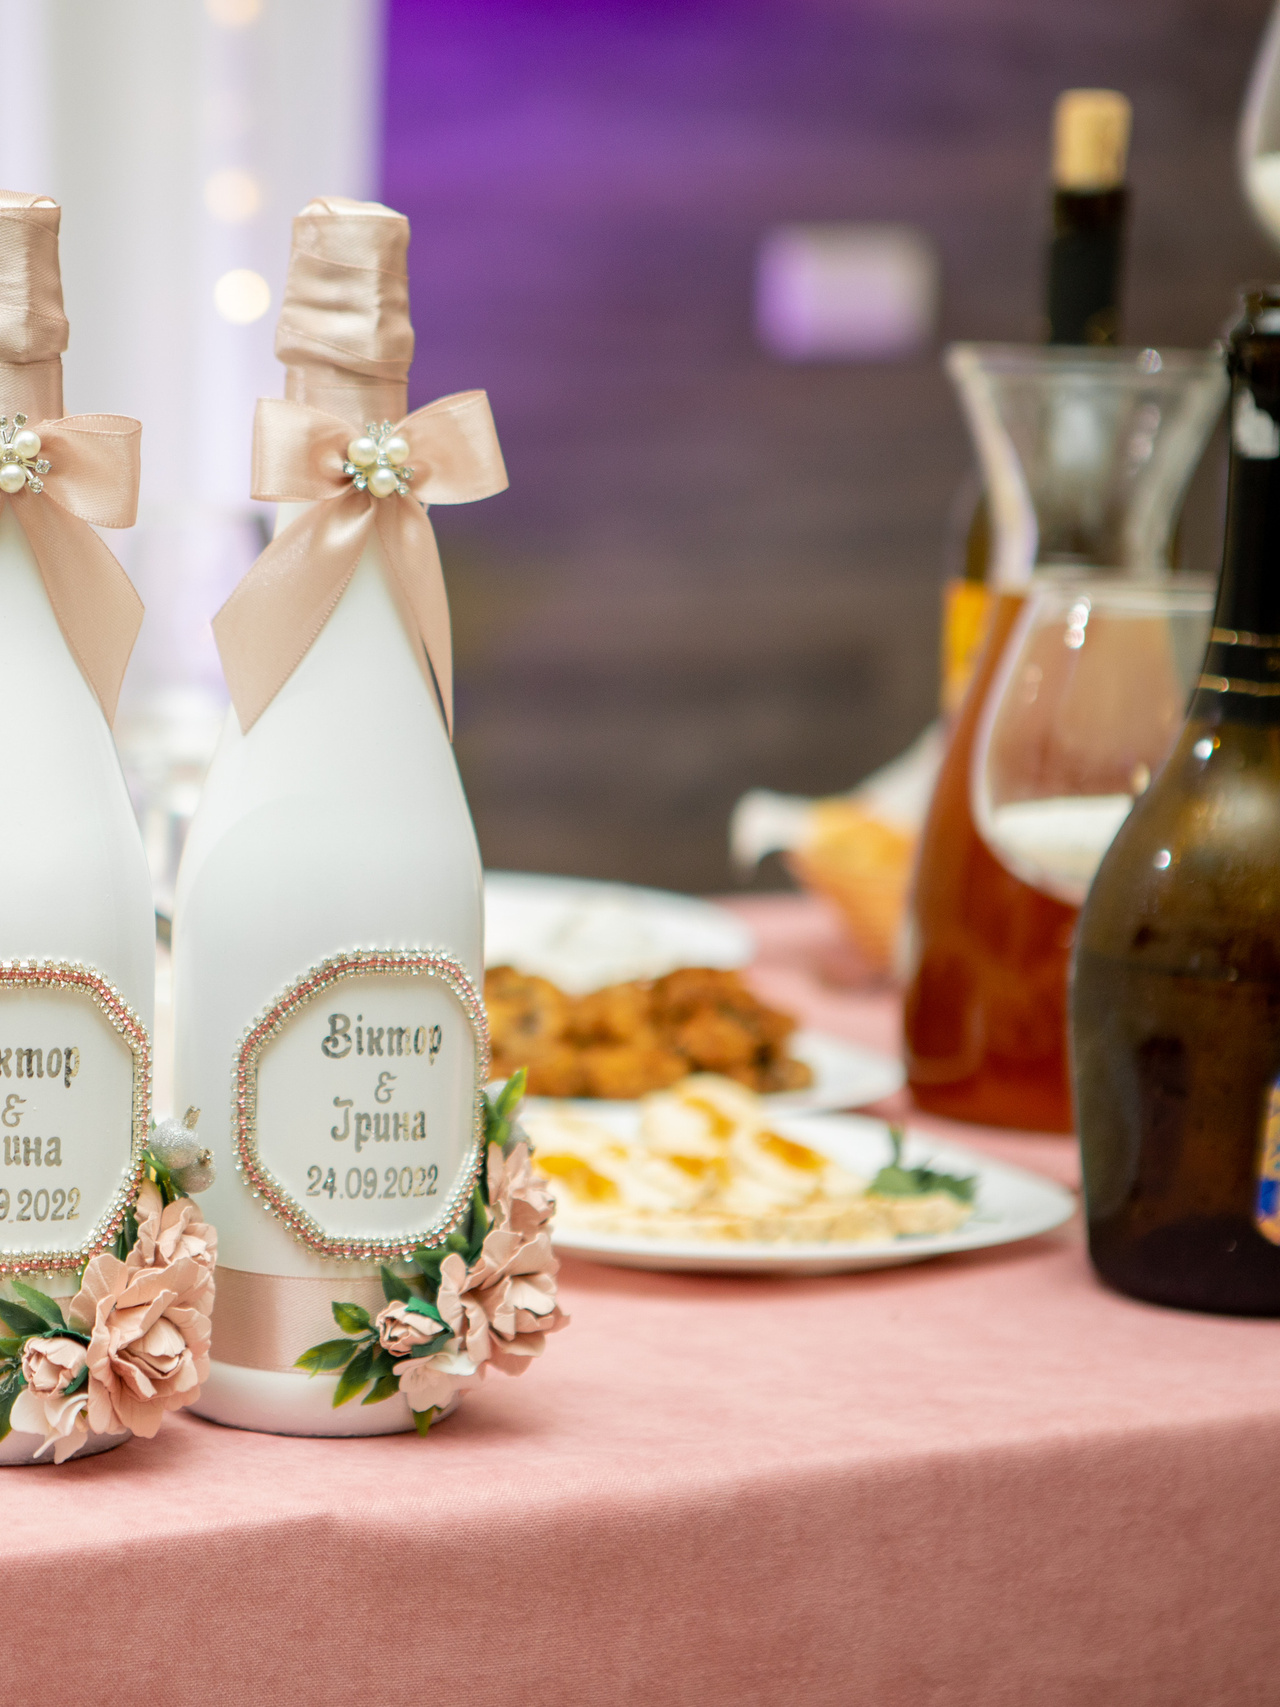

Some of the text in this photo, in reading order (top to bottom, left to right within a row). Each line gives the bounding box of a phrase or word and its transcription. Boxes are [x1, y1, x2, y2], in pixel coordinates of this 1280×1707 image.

[321, 1013, 442, 1066] Віктор
[373, 1071, 398, 1104] &
[1, 1093, 27, 1127] &
[330, 1096, 427, 1153] Ірина
[306, 1164, 439, 1199] 24.09.2022
